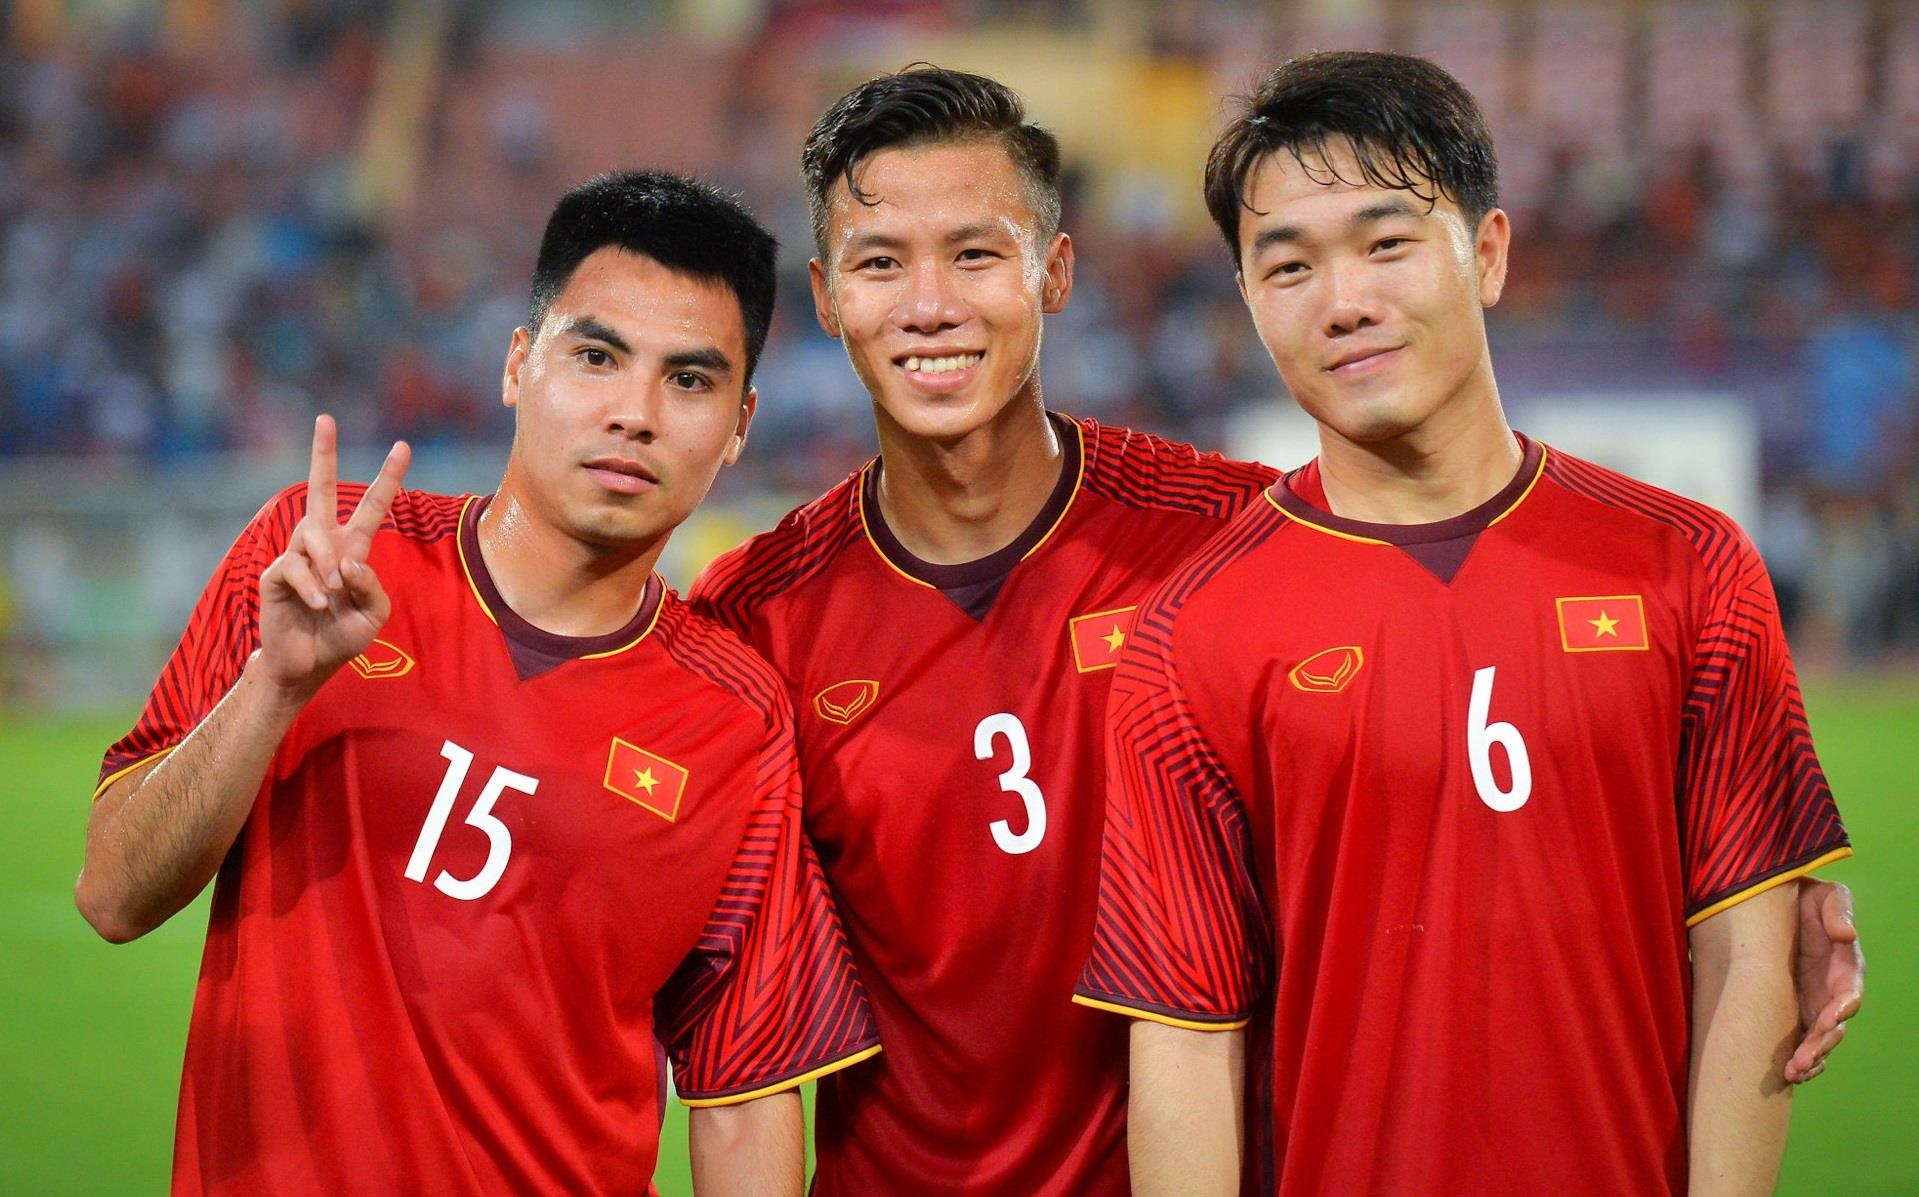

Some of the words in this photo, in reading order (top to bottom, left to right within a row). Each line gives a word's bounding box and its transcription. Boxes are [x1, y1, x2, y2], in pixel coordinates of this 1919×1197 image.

[974, 712, 1047, 855] 3
[1466, 665, 1532, 813] 6
[404, 739, 540, 901] 15
